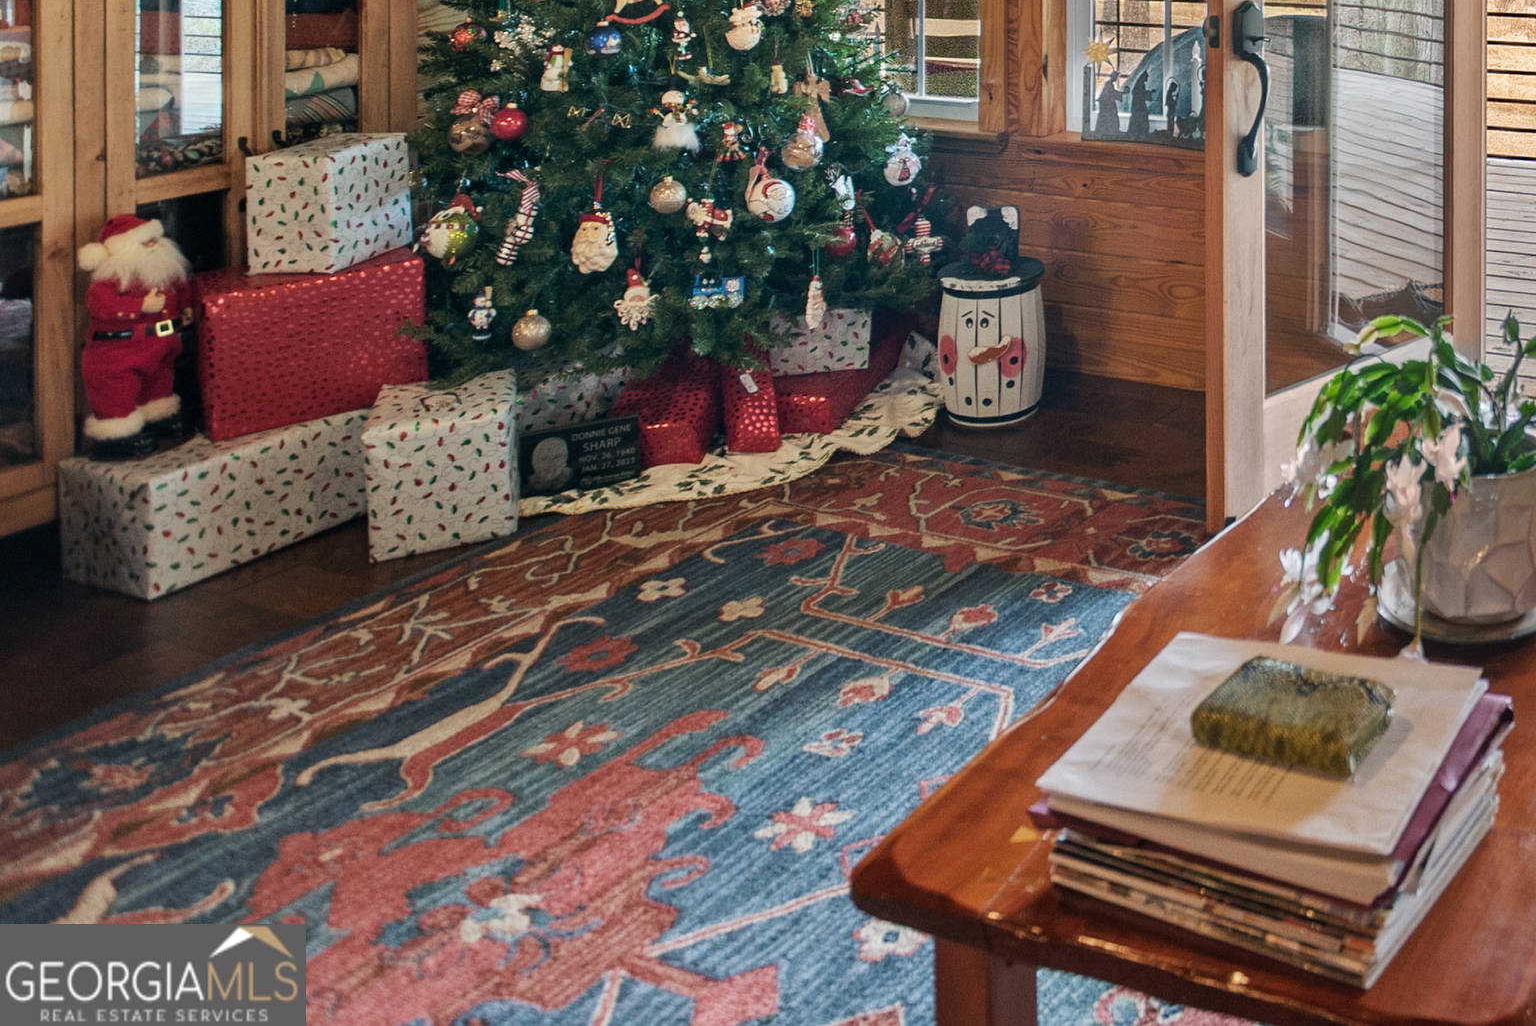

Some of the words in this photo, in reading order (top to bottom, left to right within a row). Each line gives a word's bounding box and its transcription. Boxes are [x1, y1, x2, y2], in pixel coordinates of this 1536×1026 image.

[571, 428, 606, 442] DONNIE
[607, 424, 631, 435] GENE
[582, 437, 621, 453] SHARP
[578, 454, 600, 464] NOV.
[581, 464, 600, 474] JAN.
